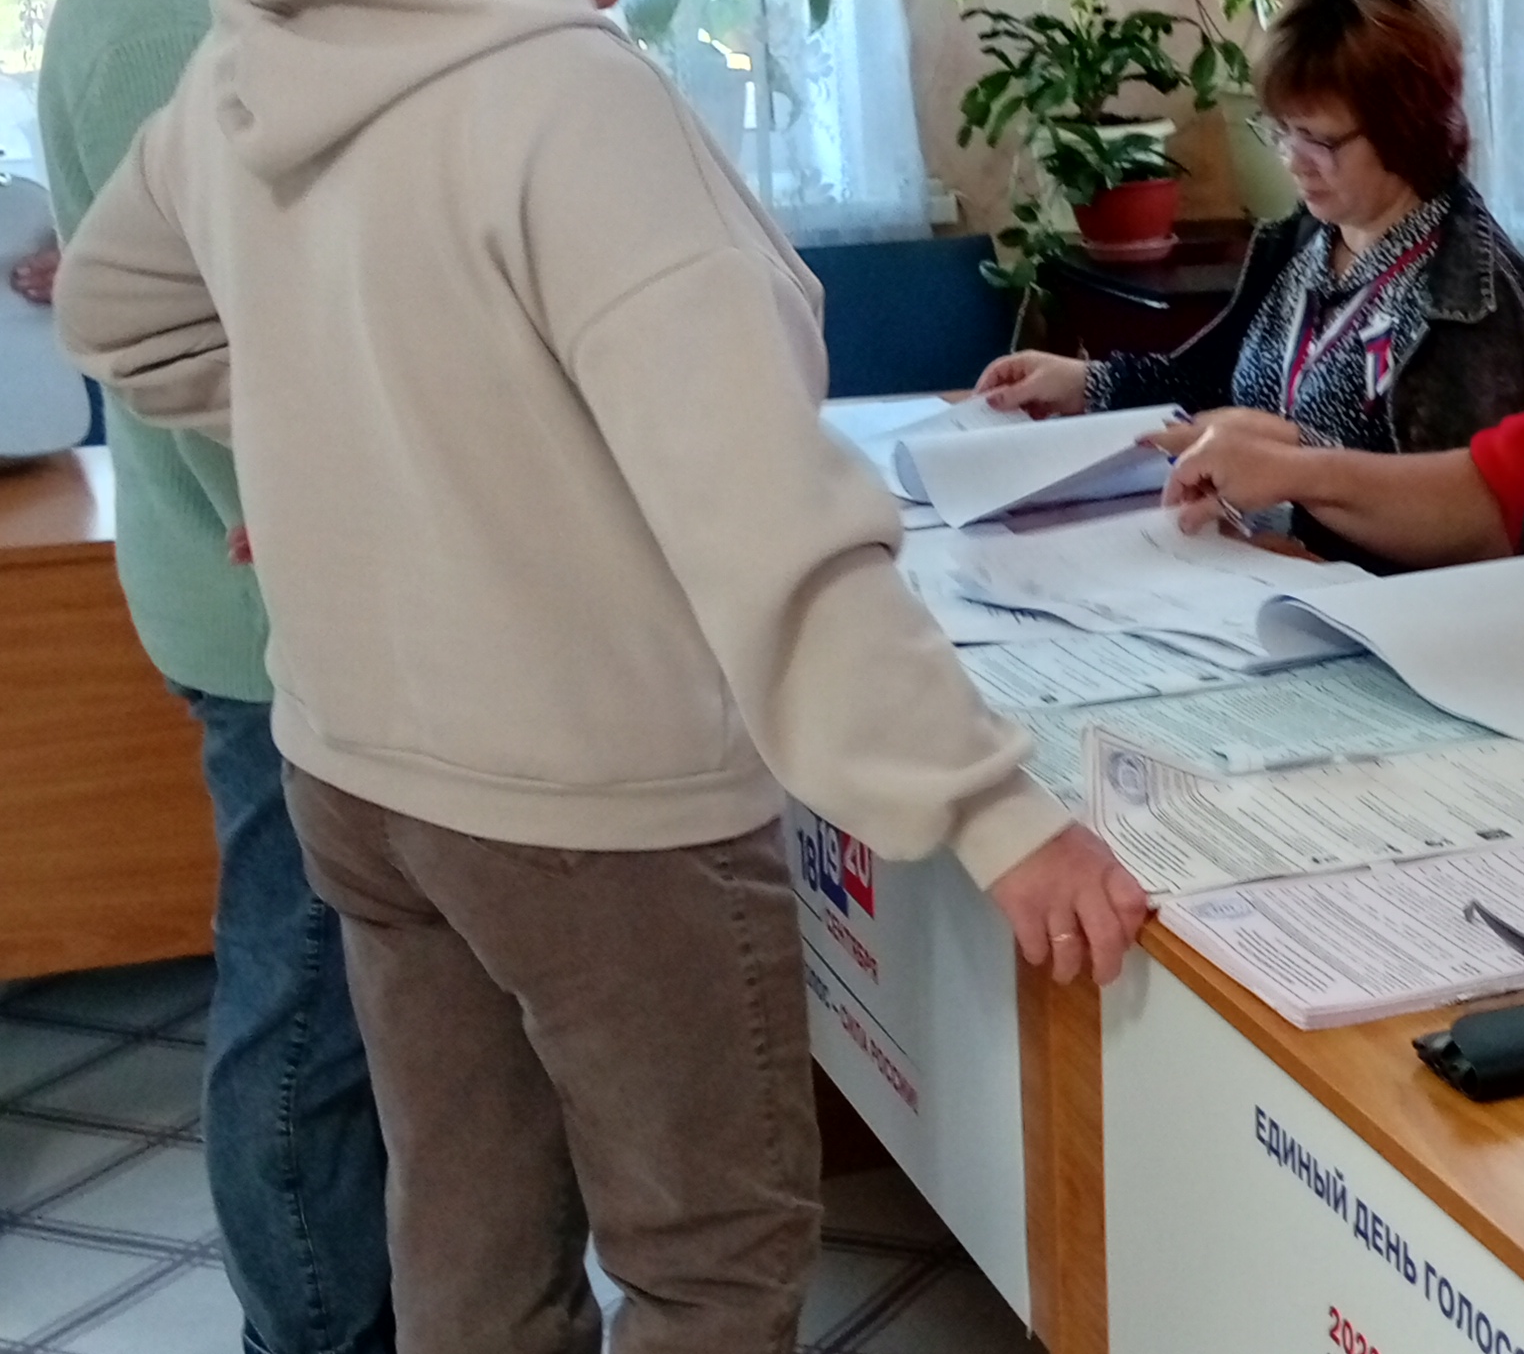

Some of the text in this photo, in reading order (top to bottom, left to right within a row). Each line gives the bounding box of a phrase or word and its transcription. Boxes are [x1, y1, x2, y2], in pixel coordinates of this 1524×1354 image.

[797, 829, 818, 892] 18
[820, 819, 841, 887] 19
[1254, 1104, 1348, 1224] ЕДИНЫЙ
[1354, 1198, 1418, 1286] ДЕНЬ
